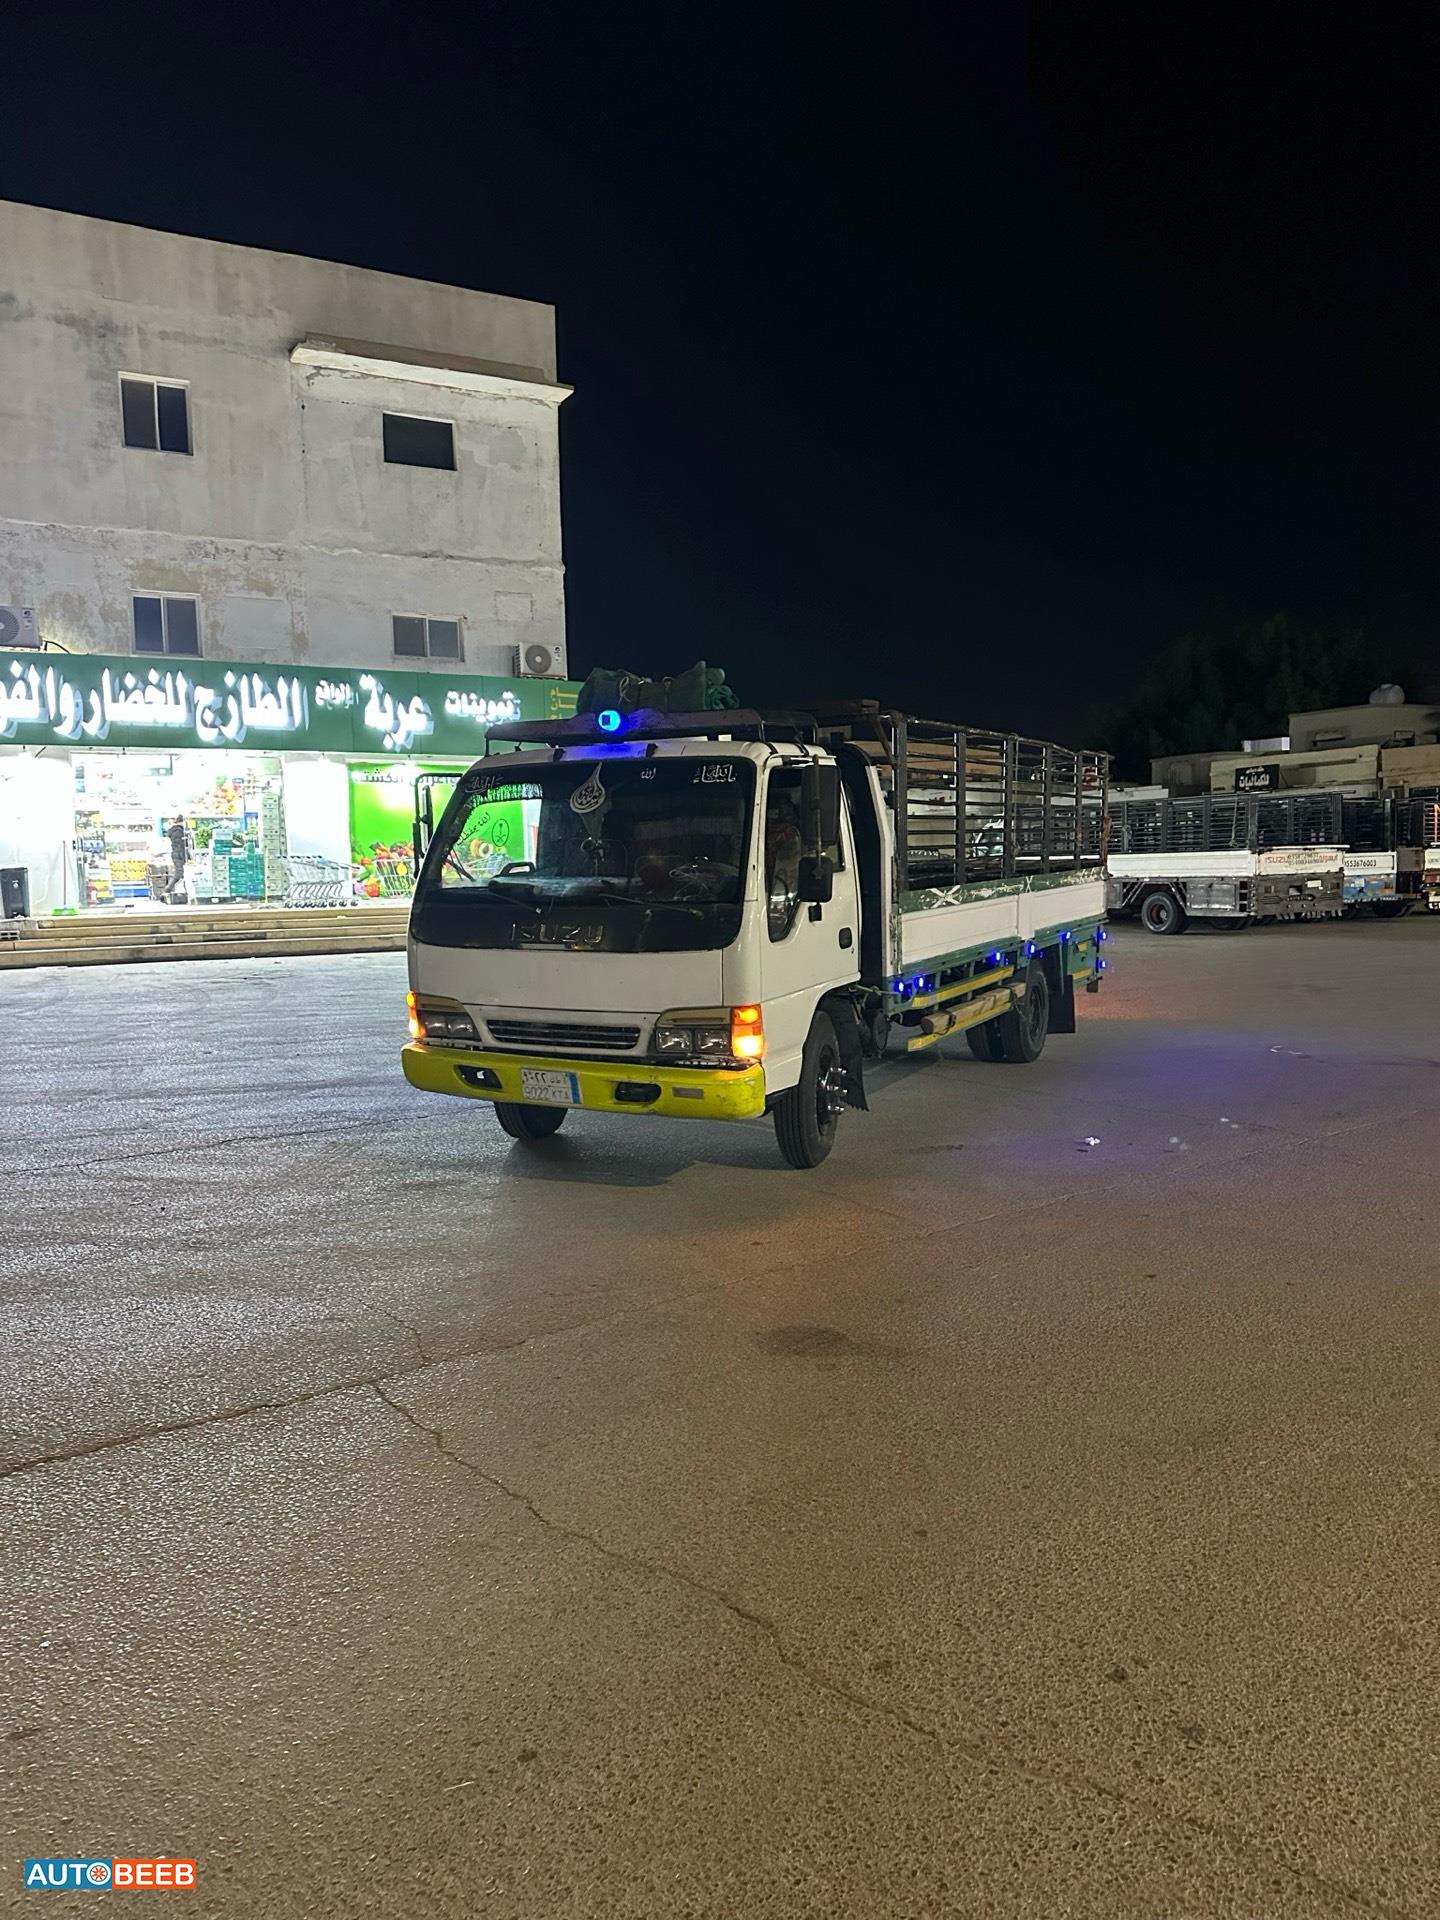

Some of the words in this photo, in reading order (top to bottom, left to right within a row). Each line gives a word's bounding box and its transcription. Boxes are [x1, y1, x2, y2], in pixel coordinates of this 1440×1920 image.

[80, 667, 190, 738] للخضار
[194, 669, 304, 742] الطازج
[358, 673, 430, 750] عربة
[444, 690, 514, 724] تموينات
[511, 922, 604, 944] ISUZU
